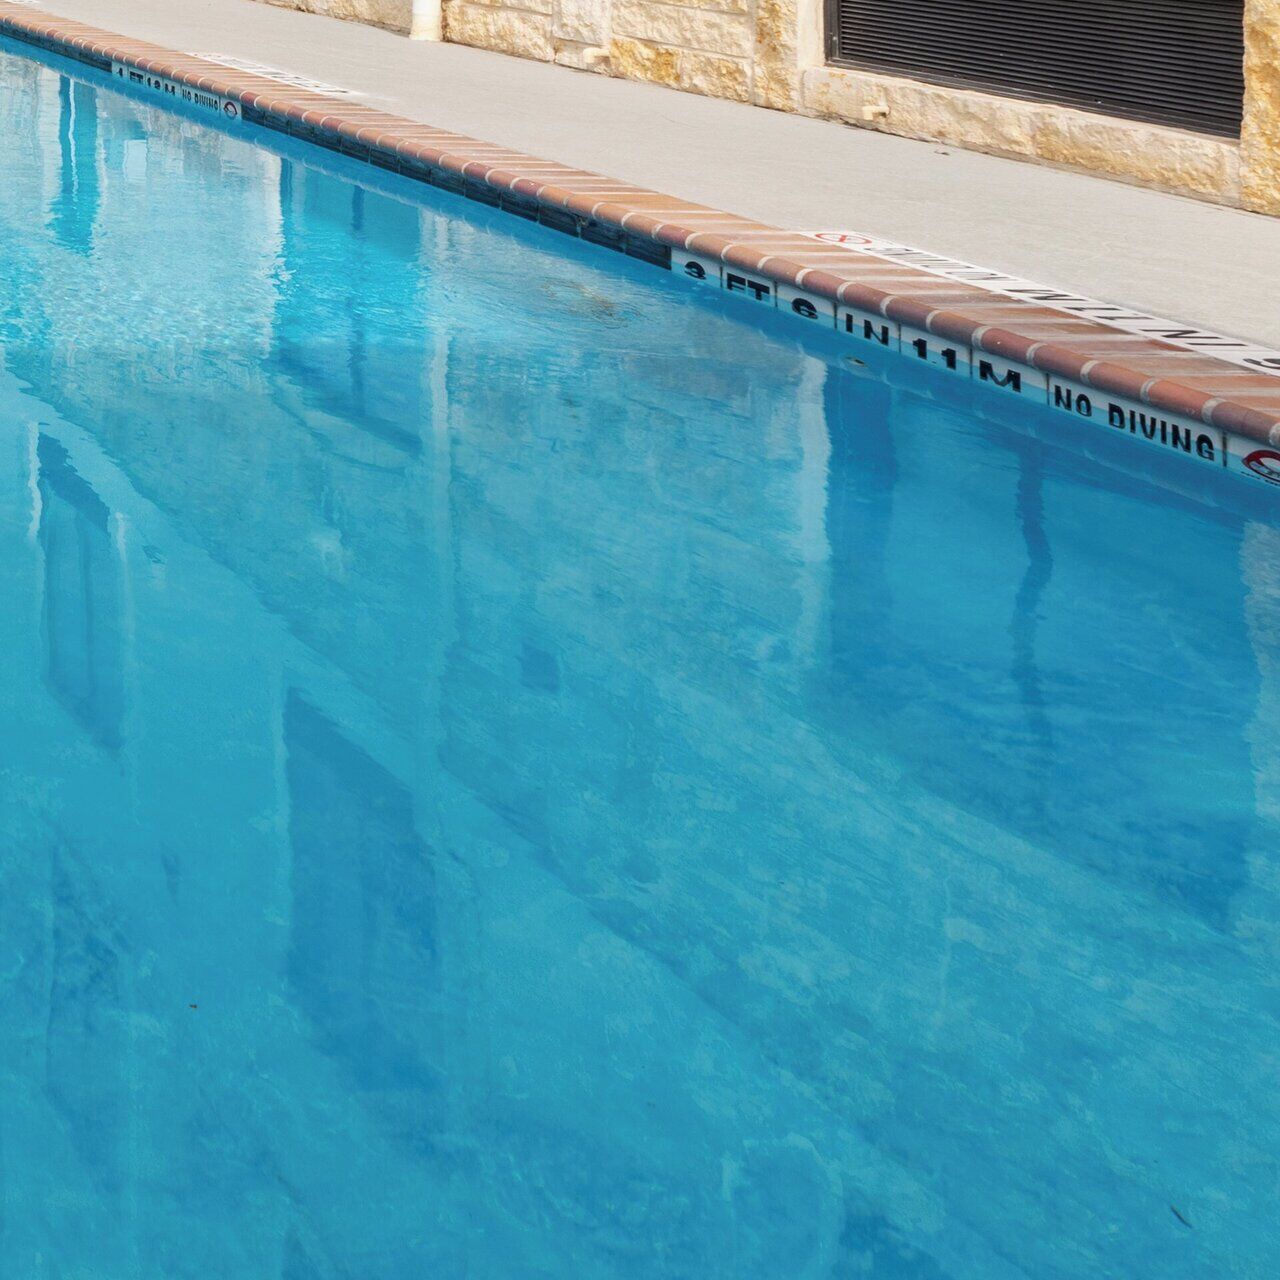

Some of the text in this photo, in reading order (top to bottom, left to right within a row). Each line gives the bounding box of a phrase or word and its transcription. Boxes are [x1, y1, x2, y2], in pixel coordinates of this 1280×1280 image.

[726, 271, 771, 301] FT
[845, 312, 889, 347] IN
[978, 359, 1022, 394] M
[1054, 384, 1093, 418] NO
[1108, 402, 1216, 462] DIVING
